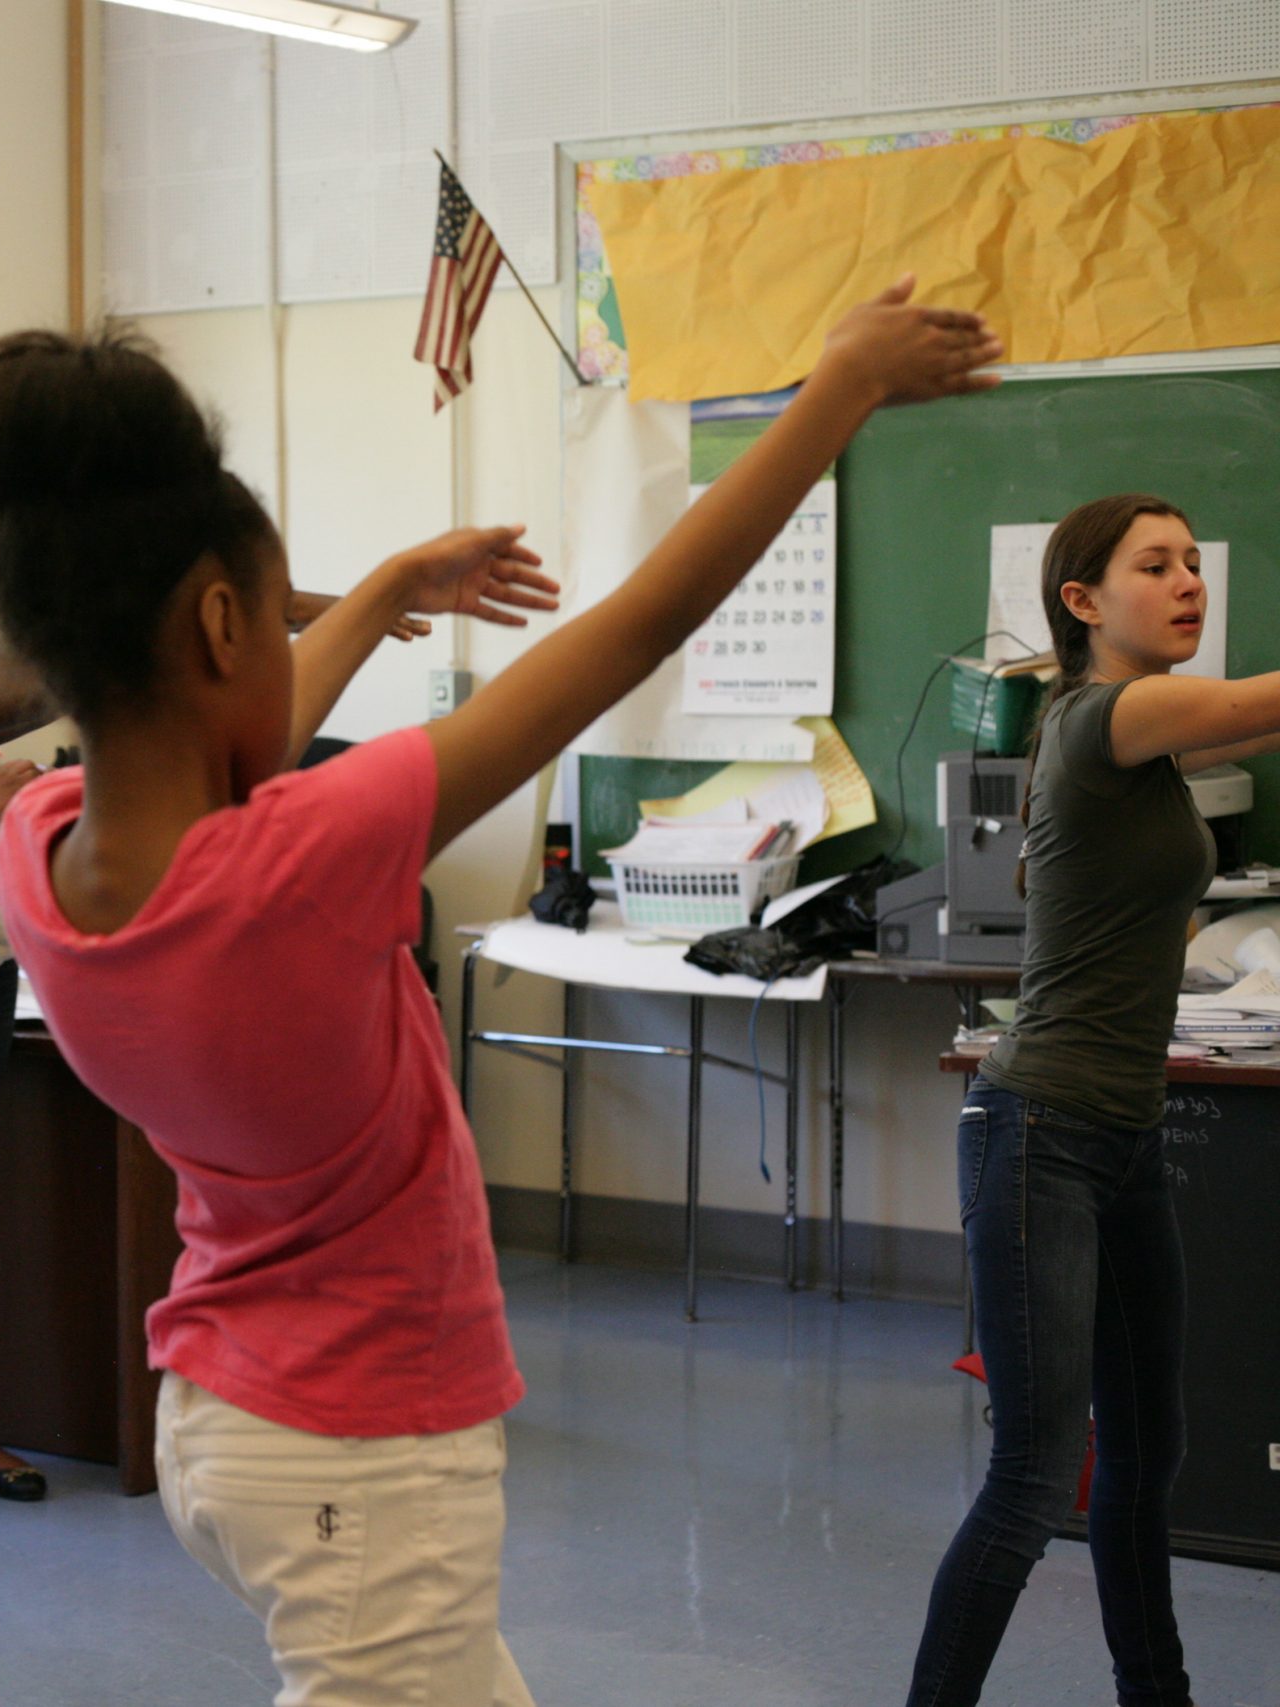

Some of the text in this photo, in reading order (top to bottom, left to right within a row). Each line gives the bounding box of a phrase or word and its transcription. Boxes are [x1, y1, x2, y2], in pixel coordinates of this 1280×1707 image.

[775, 550, 786, 562] 10
[793, 550, 804, 562] 11
[813, 550, 824, 562] 12
[755, 581, 767, 594] 16
[774, 580, 785, 594] 17
[793, 580, 805, 594] 18
[813, 580, 825, 594] 19
[716, 610, 824, 625] 21 22 23 24 25 26
[694, 641, 766, 655] 27 28 29 30
